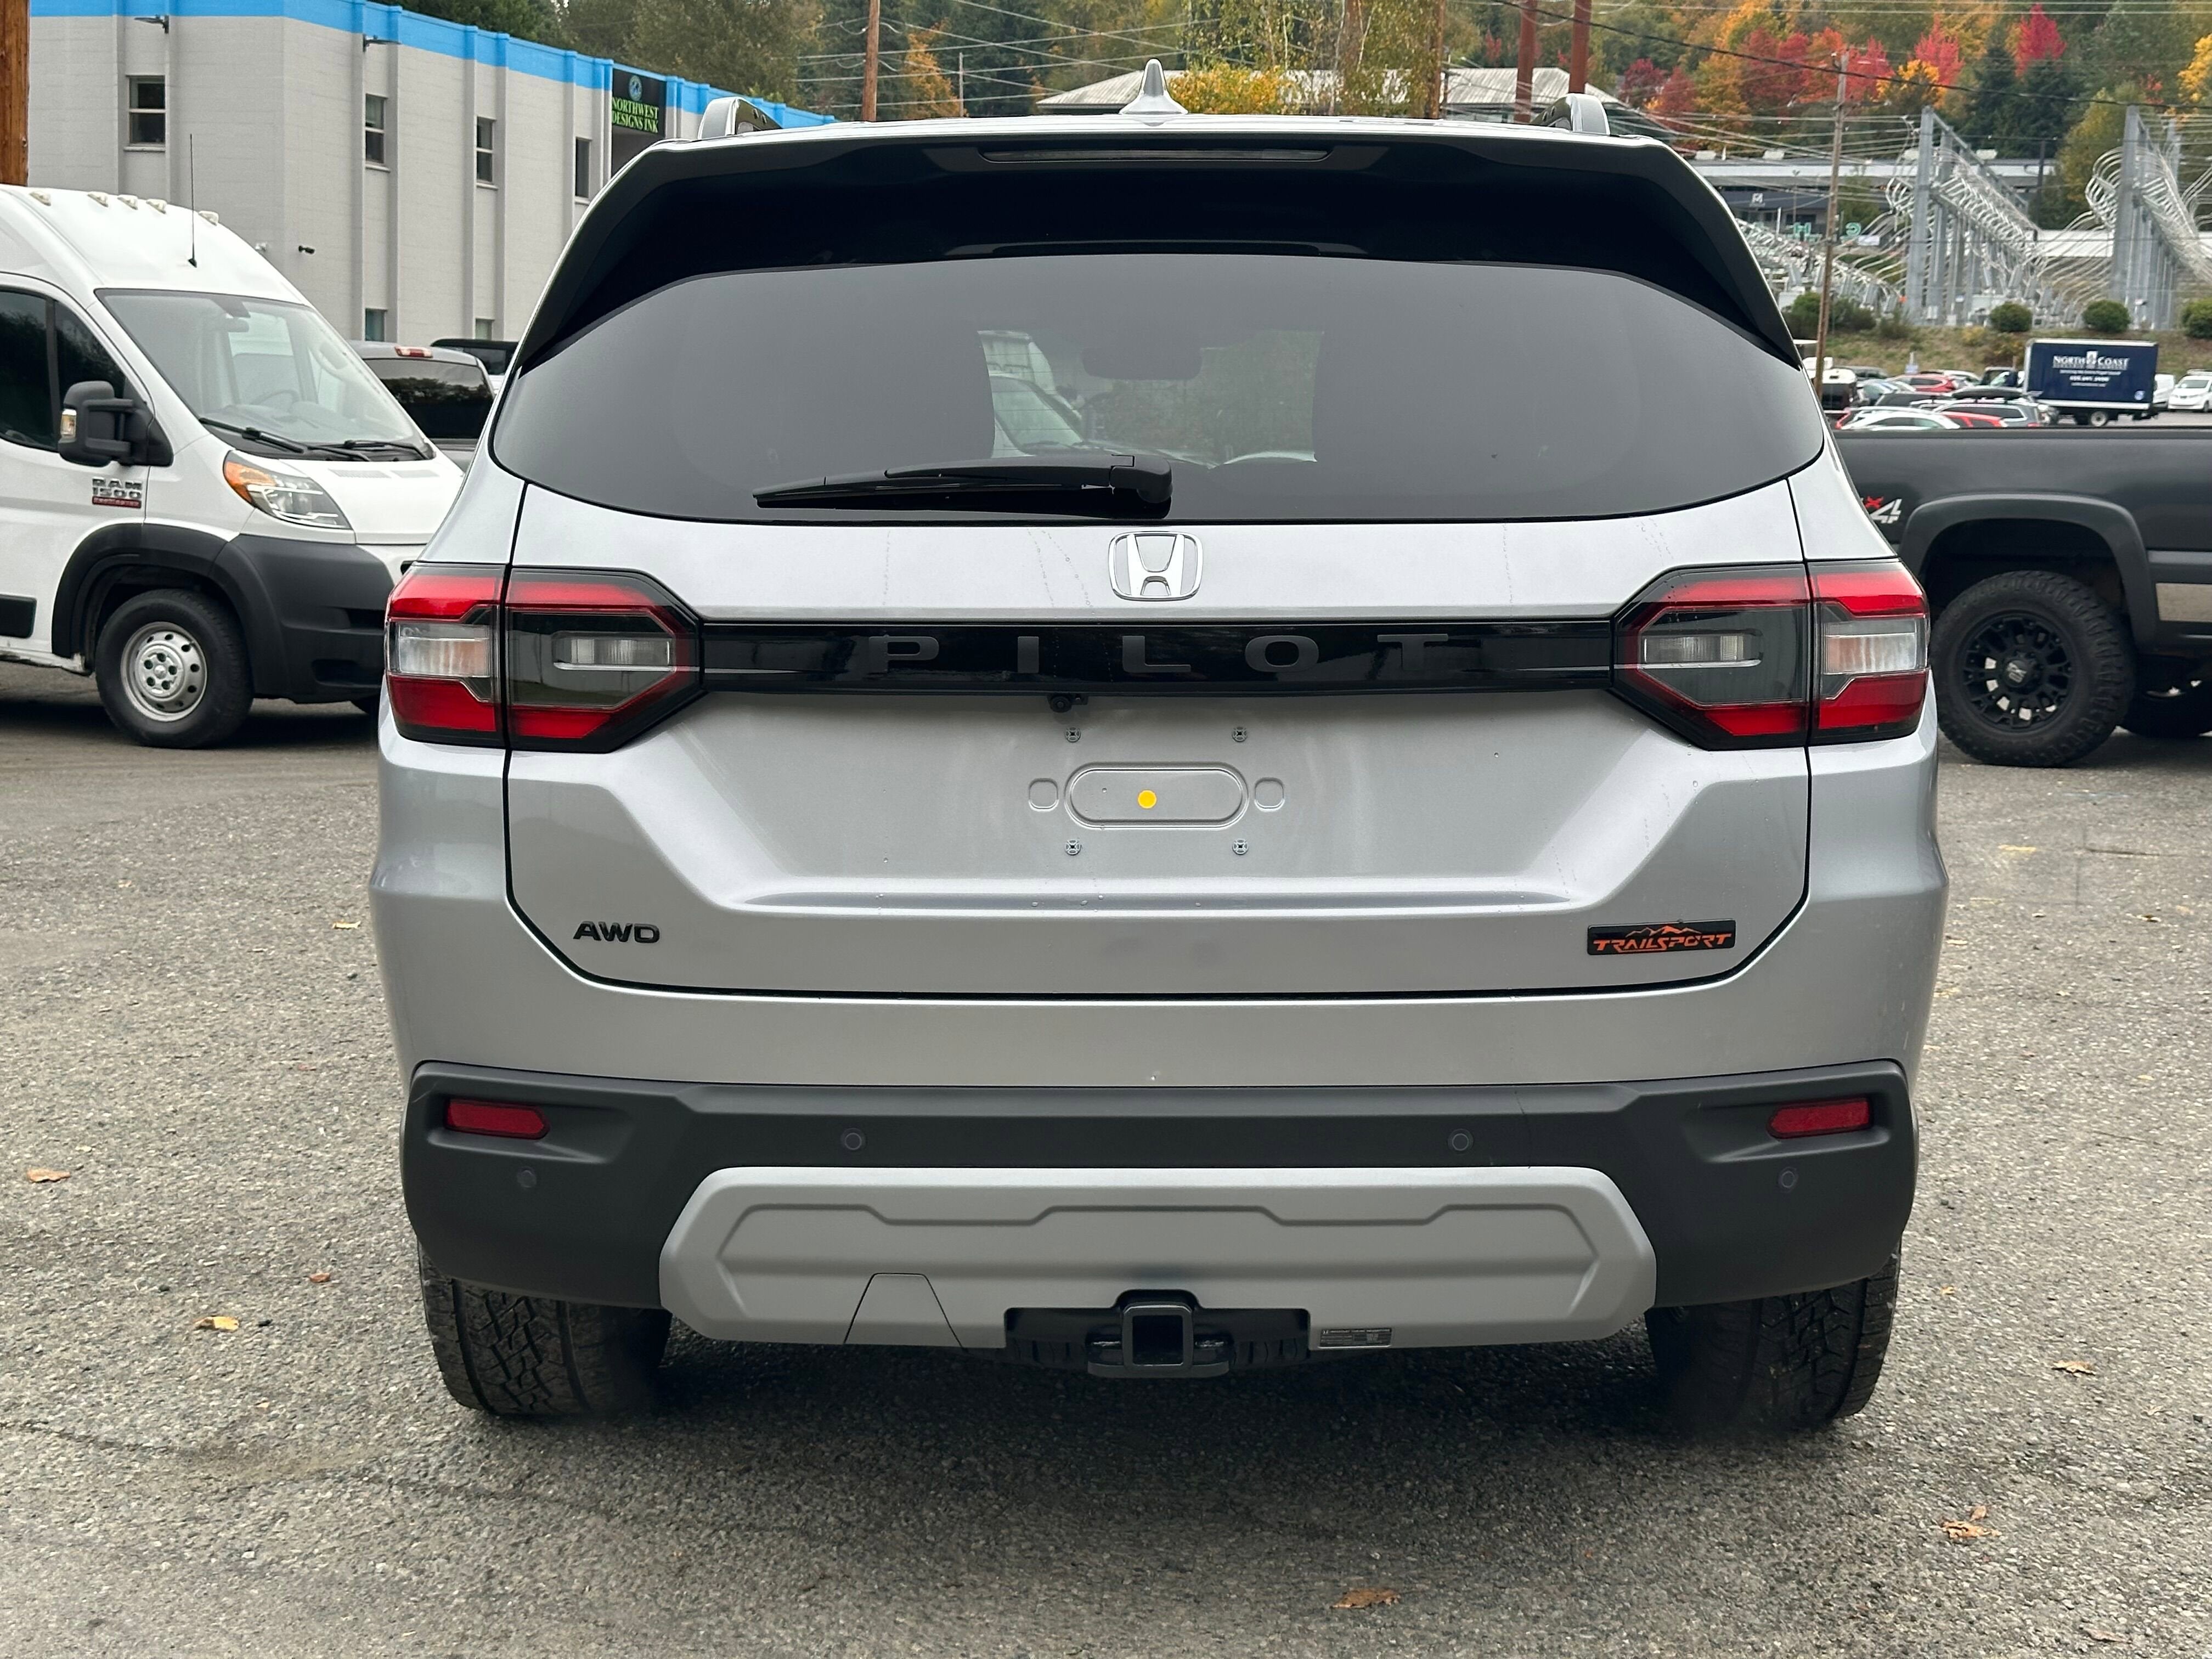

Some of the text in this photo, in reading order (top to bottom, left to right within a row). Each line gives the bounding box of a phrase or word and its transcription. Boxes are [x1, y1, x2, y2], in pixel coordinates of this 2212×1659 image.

[612, 97, 659, 119] NORTHWEST
[612, 110, 658, 133] DESIGNS INK
[2053, 356, 2129, 365] NORTH COAST
[92, 477, 142, 490] RAM
[92, 487, 142, 499] 1500
[1860, 496, 1902, 524] x4
[868, 634, 1448, 673] PILOT
[573, 921, 660, 943] AWD
[1593, 933, 1732, 952] TRAILSPORT
